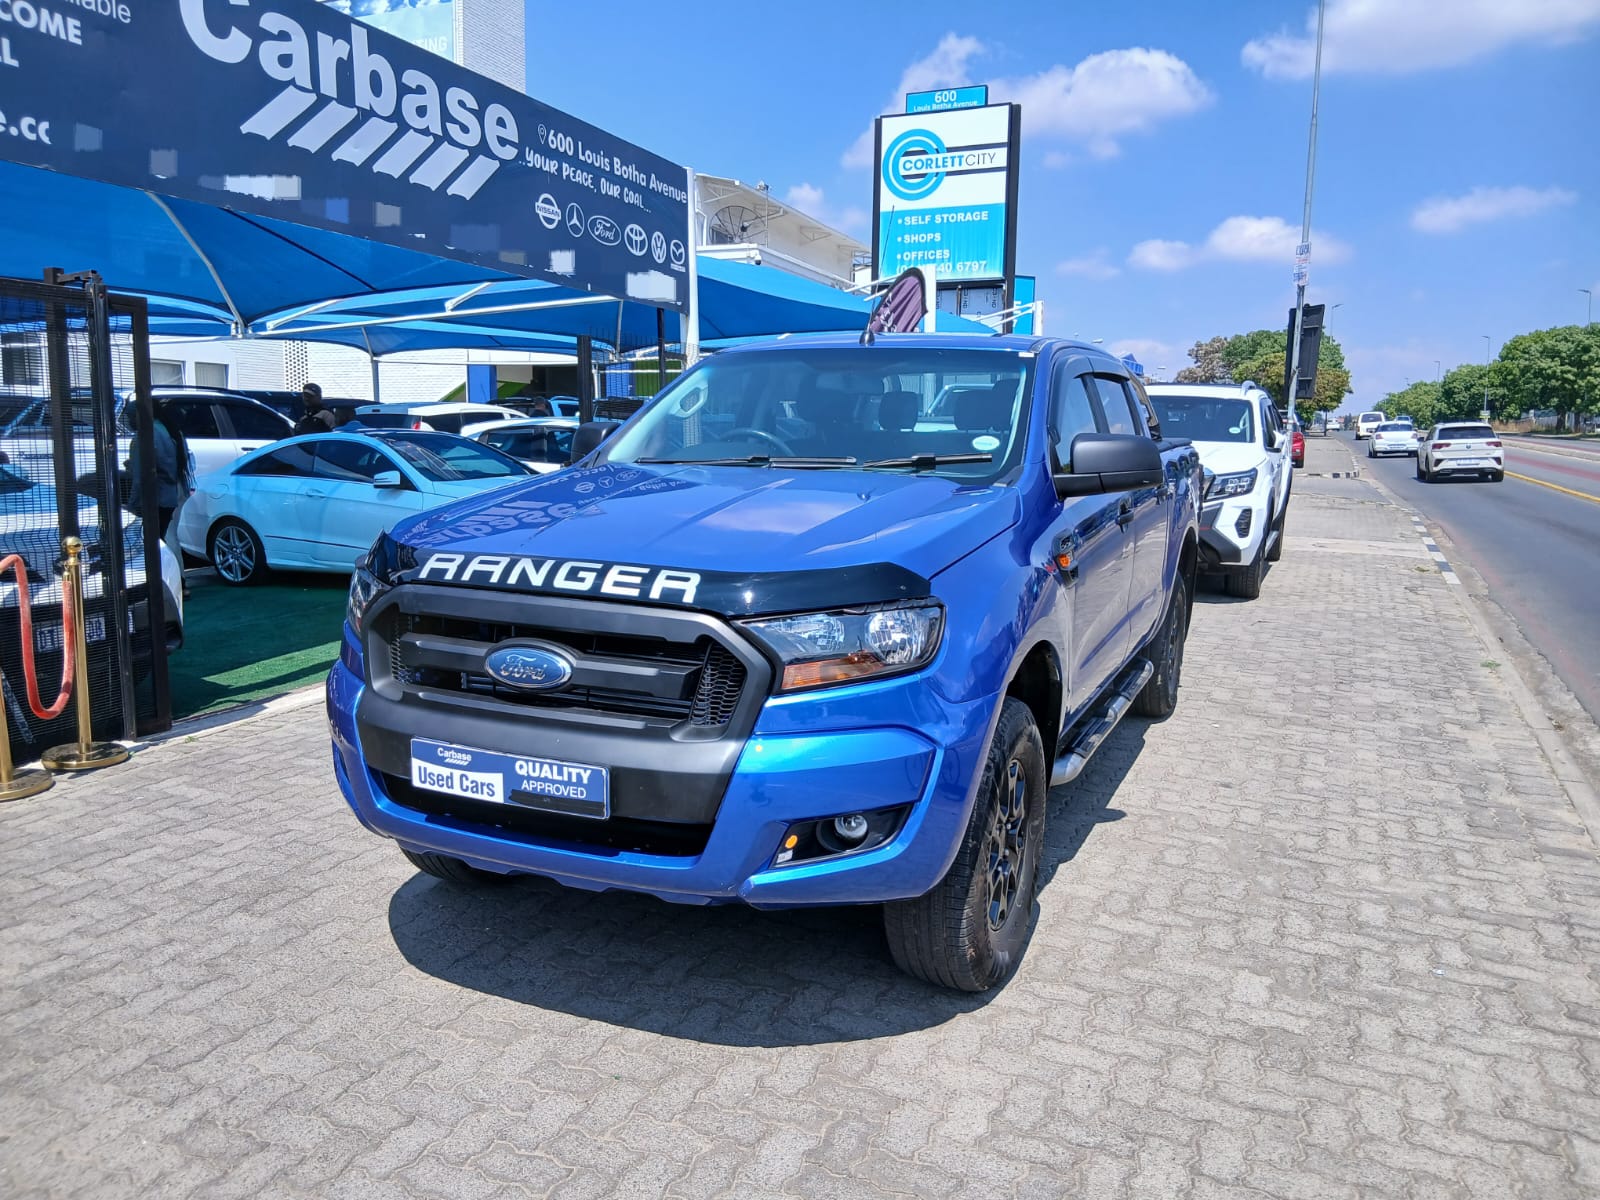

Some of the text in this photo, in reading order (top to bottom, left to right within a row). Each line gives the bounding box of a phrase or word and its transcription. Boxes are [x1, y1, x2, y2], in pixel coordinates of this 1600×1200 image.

[179, 0, 520, 161] Carbase
[935, 91, 957, 103] 600
[913, 104, 931, 112] Louis
[548, 129, 688, 204] 600 Louis Botha Avenue
[536, 204, 561, 219] NISSAN
[904, 211, 989, 226] SELF STORAGE
[594, 219, 616, 240] Ford
[903, 233, 941, 244] SHOPS
[903, 249, 951, 261] OFFICES
[956, 261, 987, 272] 6797
[419, 553, 701, 603] RANGER
[499, 654, 547, 682] Ford
[437, 747, 472, 762] Carbase
[418, 765, 495, 797] Used Cars
[515, 761, 592, 784] QUALITY
[521, 780, 587, 799] APPROVED
